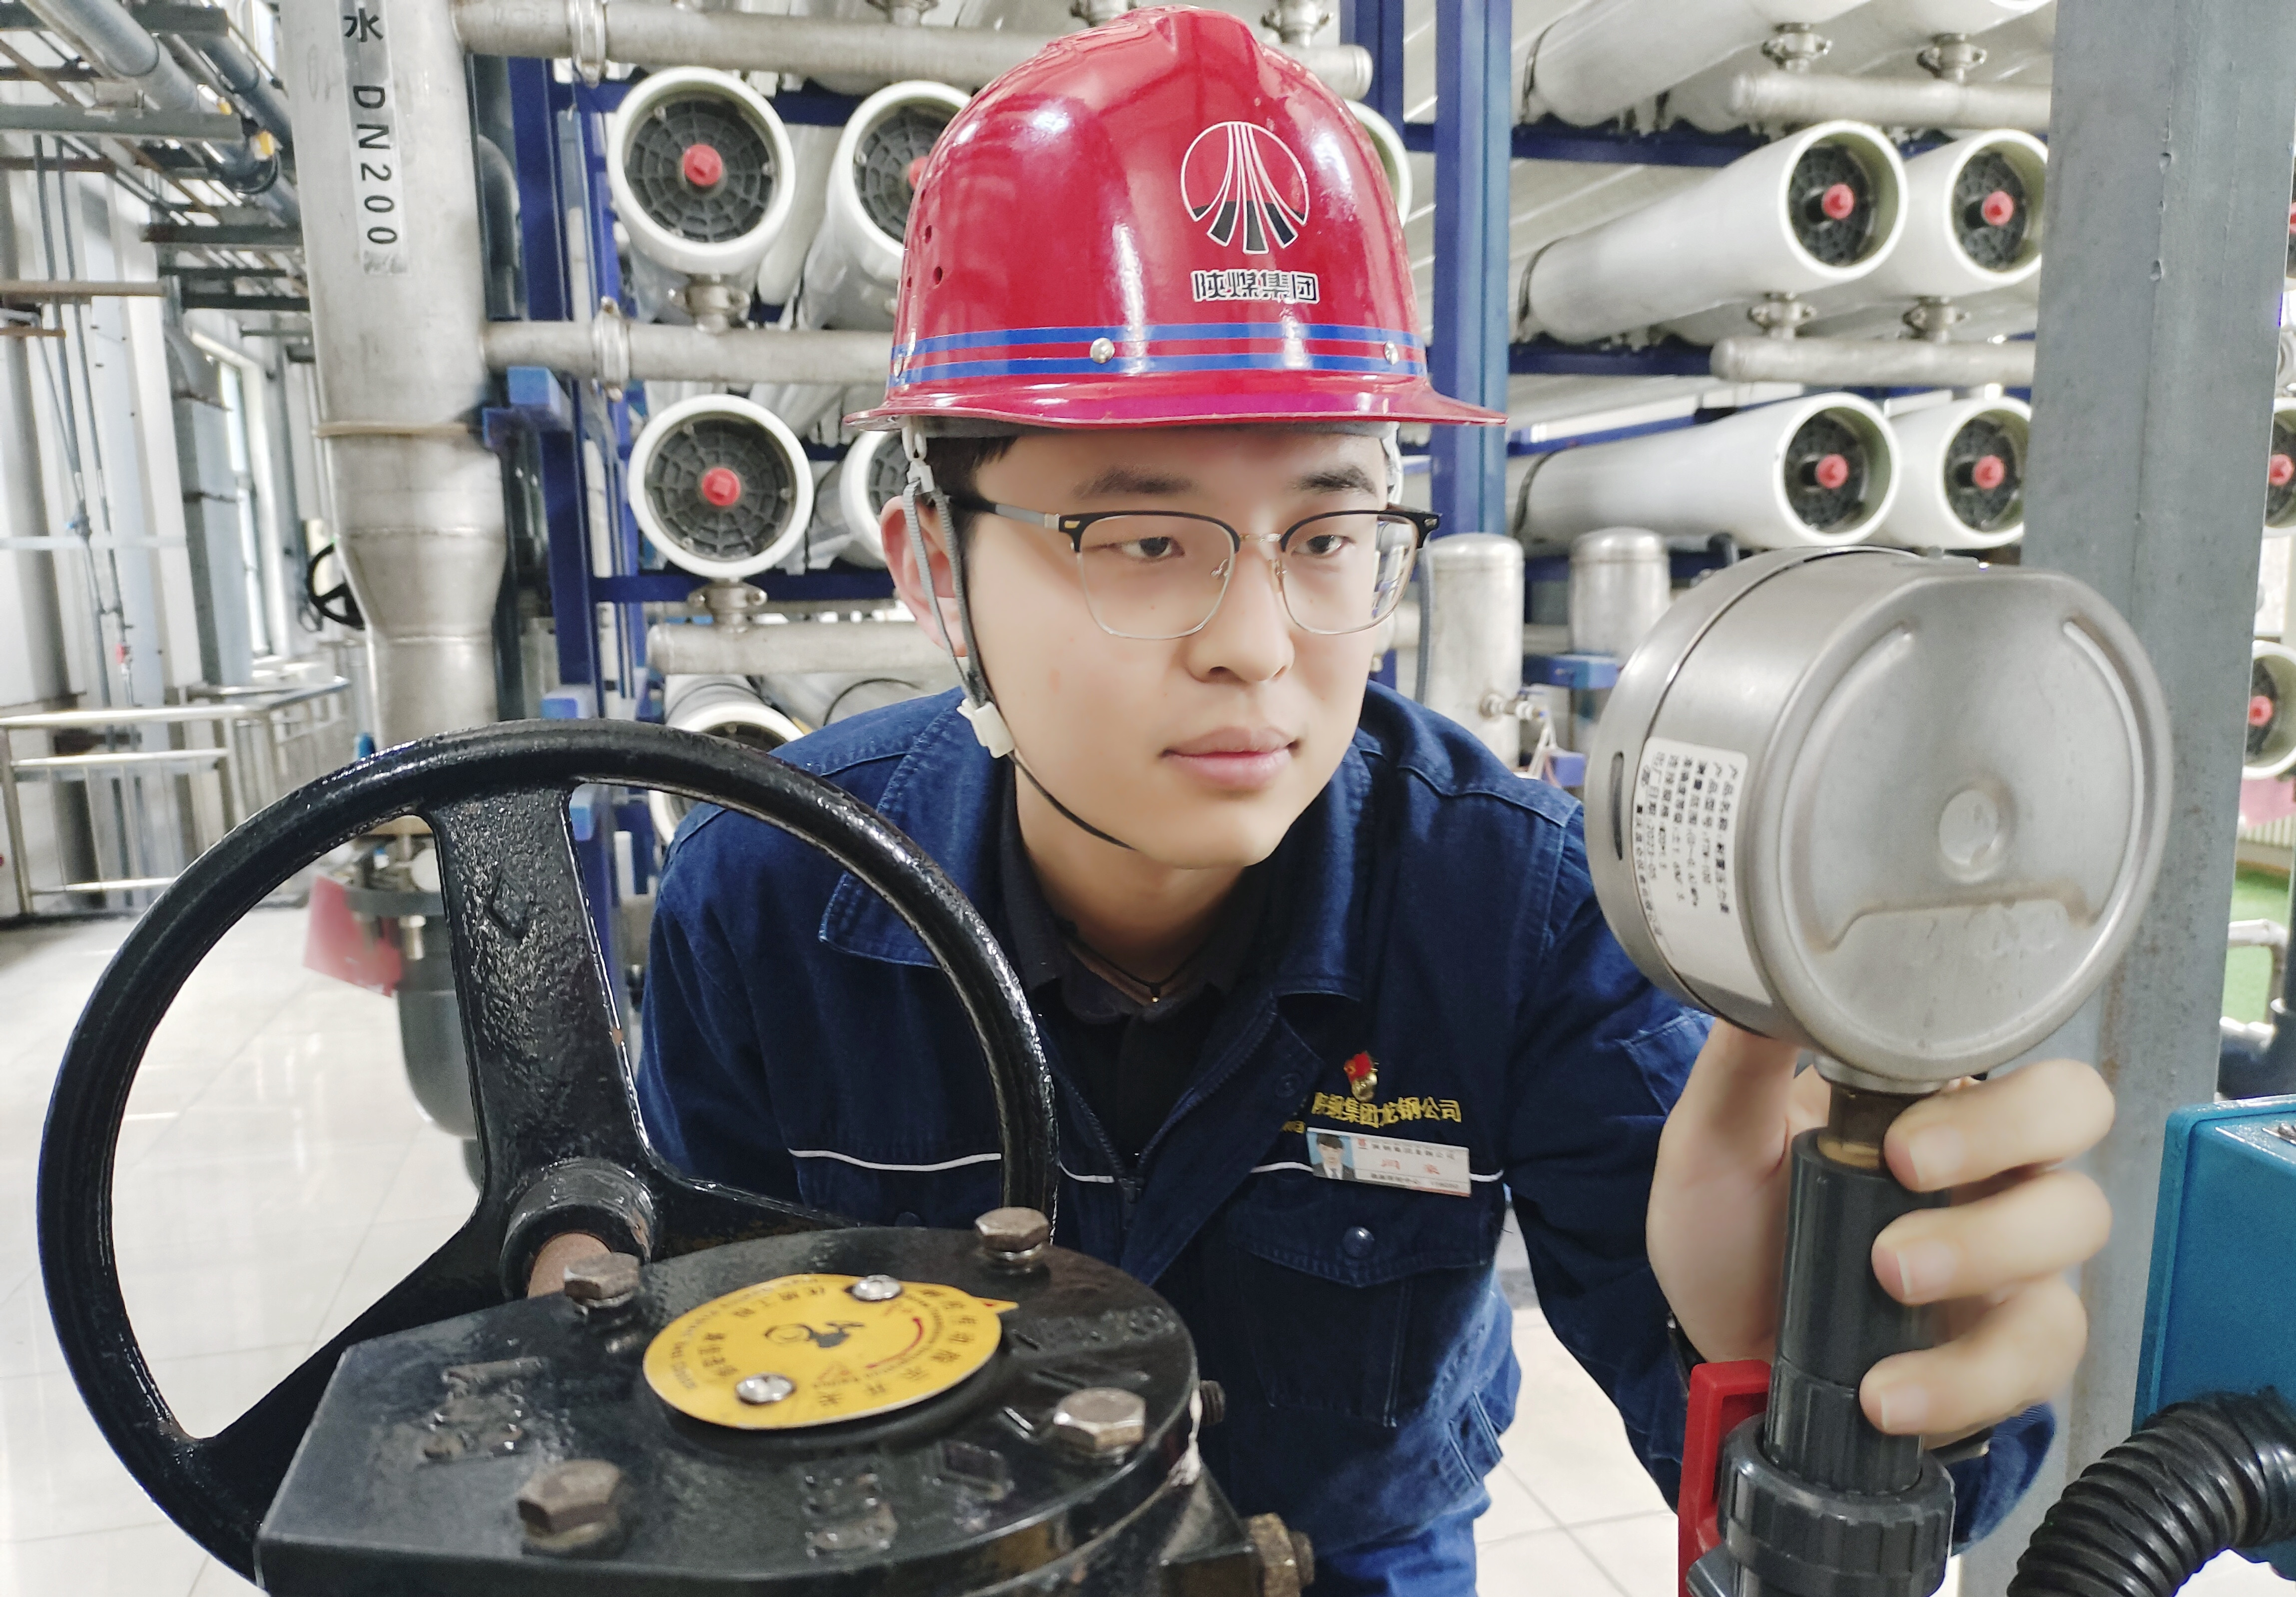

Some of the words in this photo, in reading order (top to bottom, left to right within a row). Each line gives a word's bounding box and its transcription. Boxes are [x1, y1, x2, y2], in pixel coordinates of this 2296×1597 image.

[343, 7, 384, 42] 水
[352, 85, 398, 244] DN200
[1192, 269, 1319, 302] 陕煤集团
